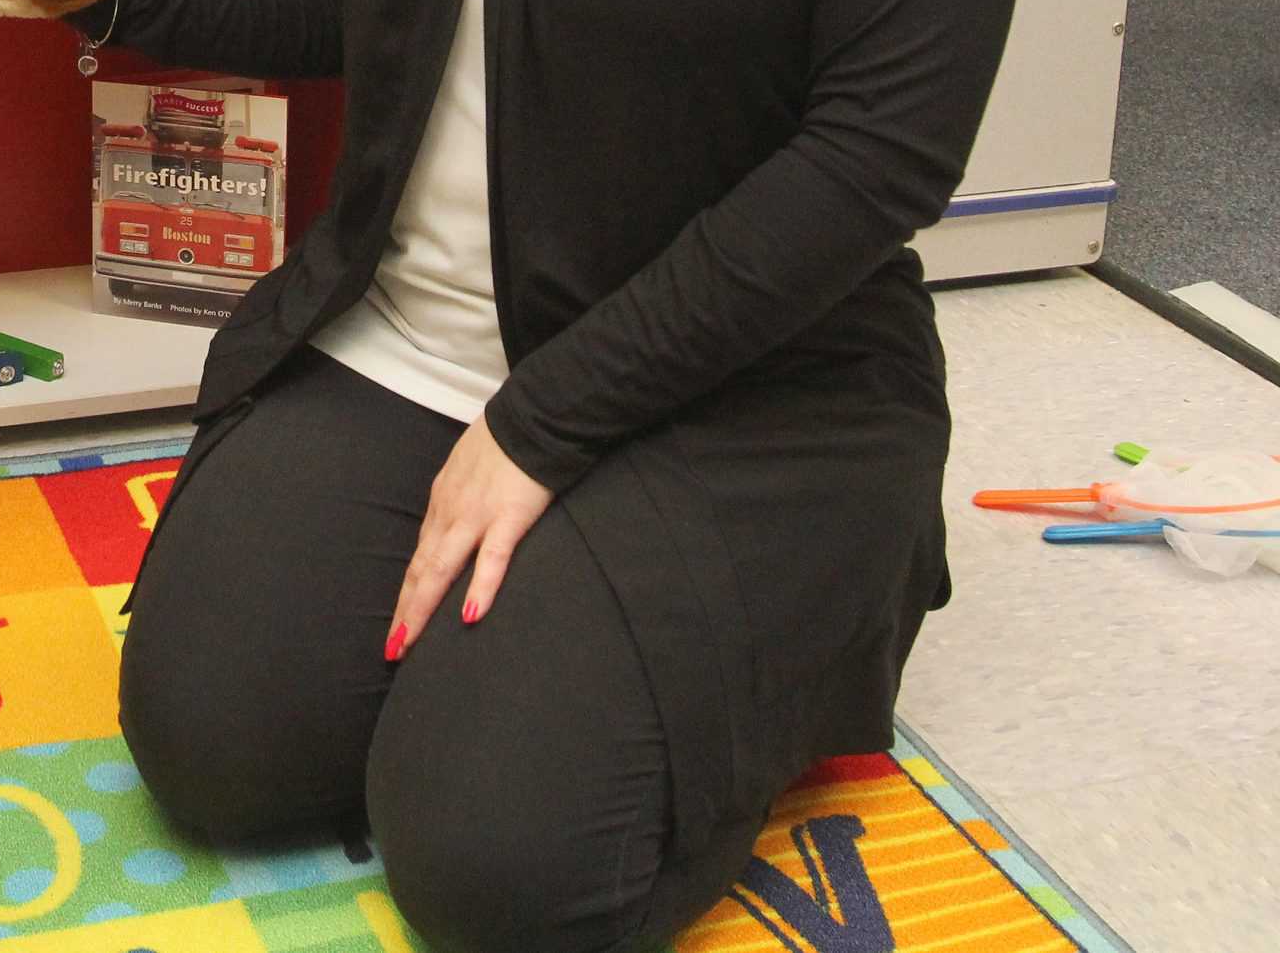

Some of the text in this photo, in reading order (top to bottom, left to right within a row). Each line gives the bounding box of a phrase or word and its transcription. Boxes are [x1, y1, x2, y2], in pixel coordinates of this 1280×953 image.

[185, 102, 220, 113] SUCCESS
[112, 163, 268, 198] Firefighters!
[161, 226, 212, 245] Boston
[170, 304, 192, 314] Photos
[193, 307, 202, 316] by
[203, 308, 217, 317] Ken
